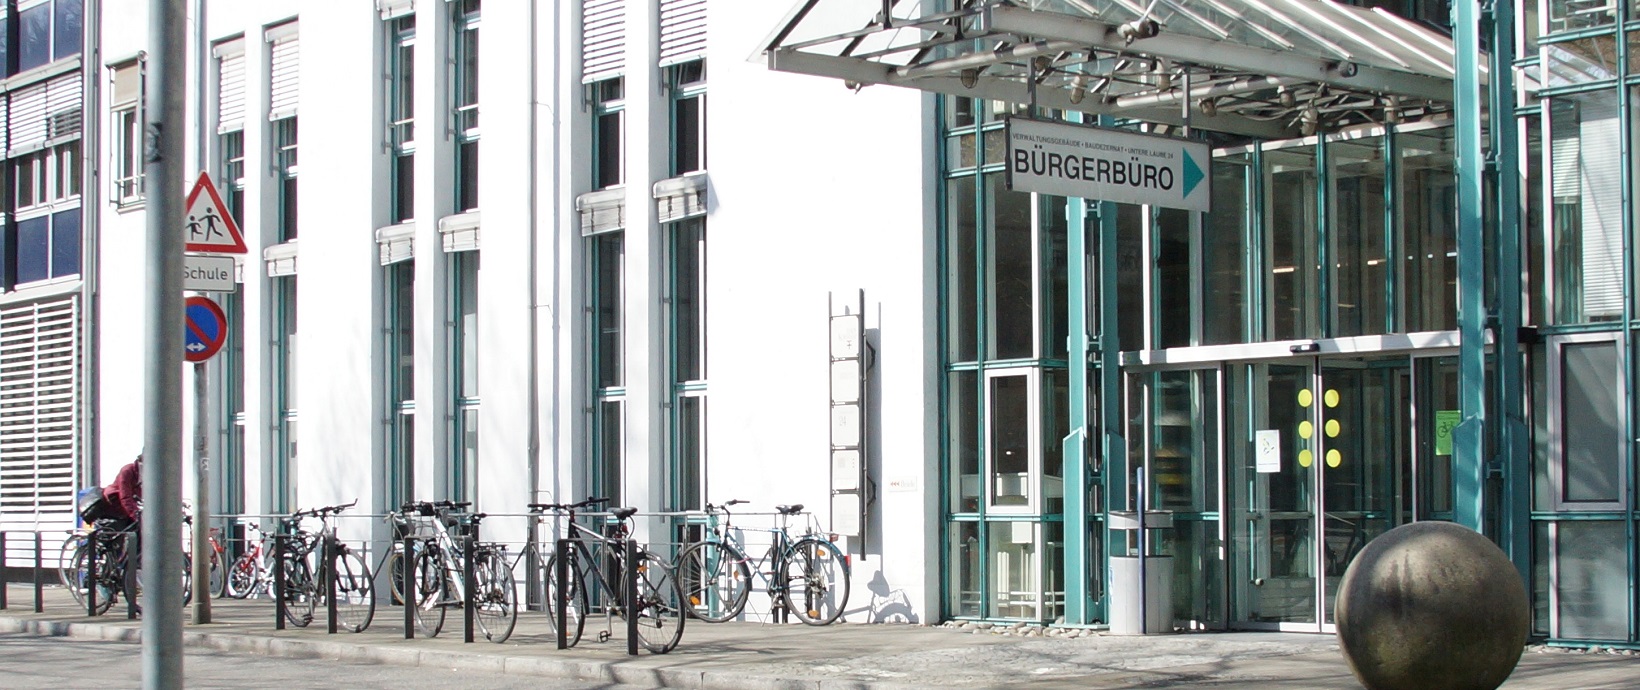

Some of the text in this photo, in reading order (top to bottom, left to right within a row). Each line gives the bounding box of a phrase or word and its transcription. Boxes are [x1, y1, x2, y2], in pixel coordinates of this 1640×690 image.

[1012, 133, 1080, 147] VERWALTUNGSGEBÄUDE
[1084, 142, 1124, 152] BAUDEZERNAT
[1128, 148, 1148, 156] UNTERE
[1015, 145, 1173, 190] BÜRGERBÜRO
[184, 266, 228, 280] Schule
